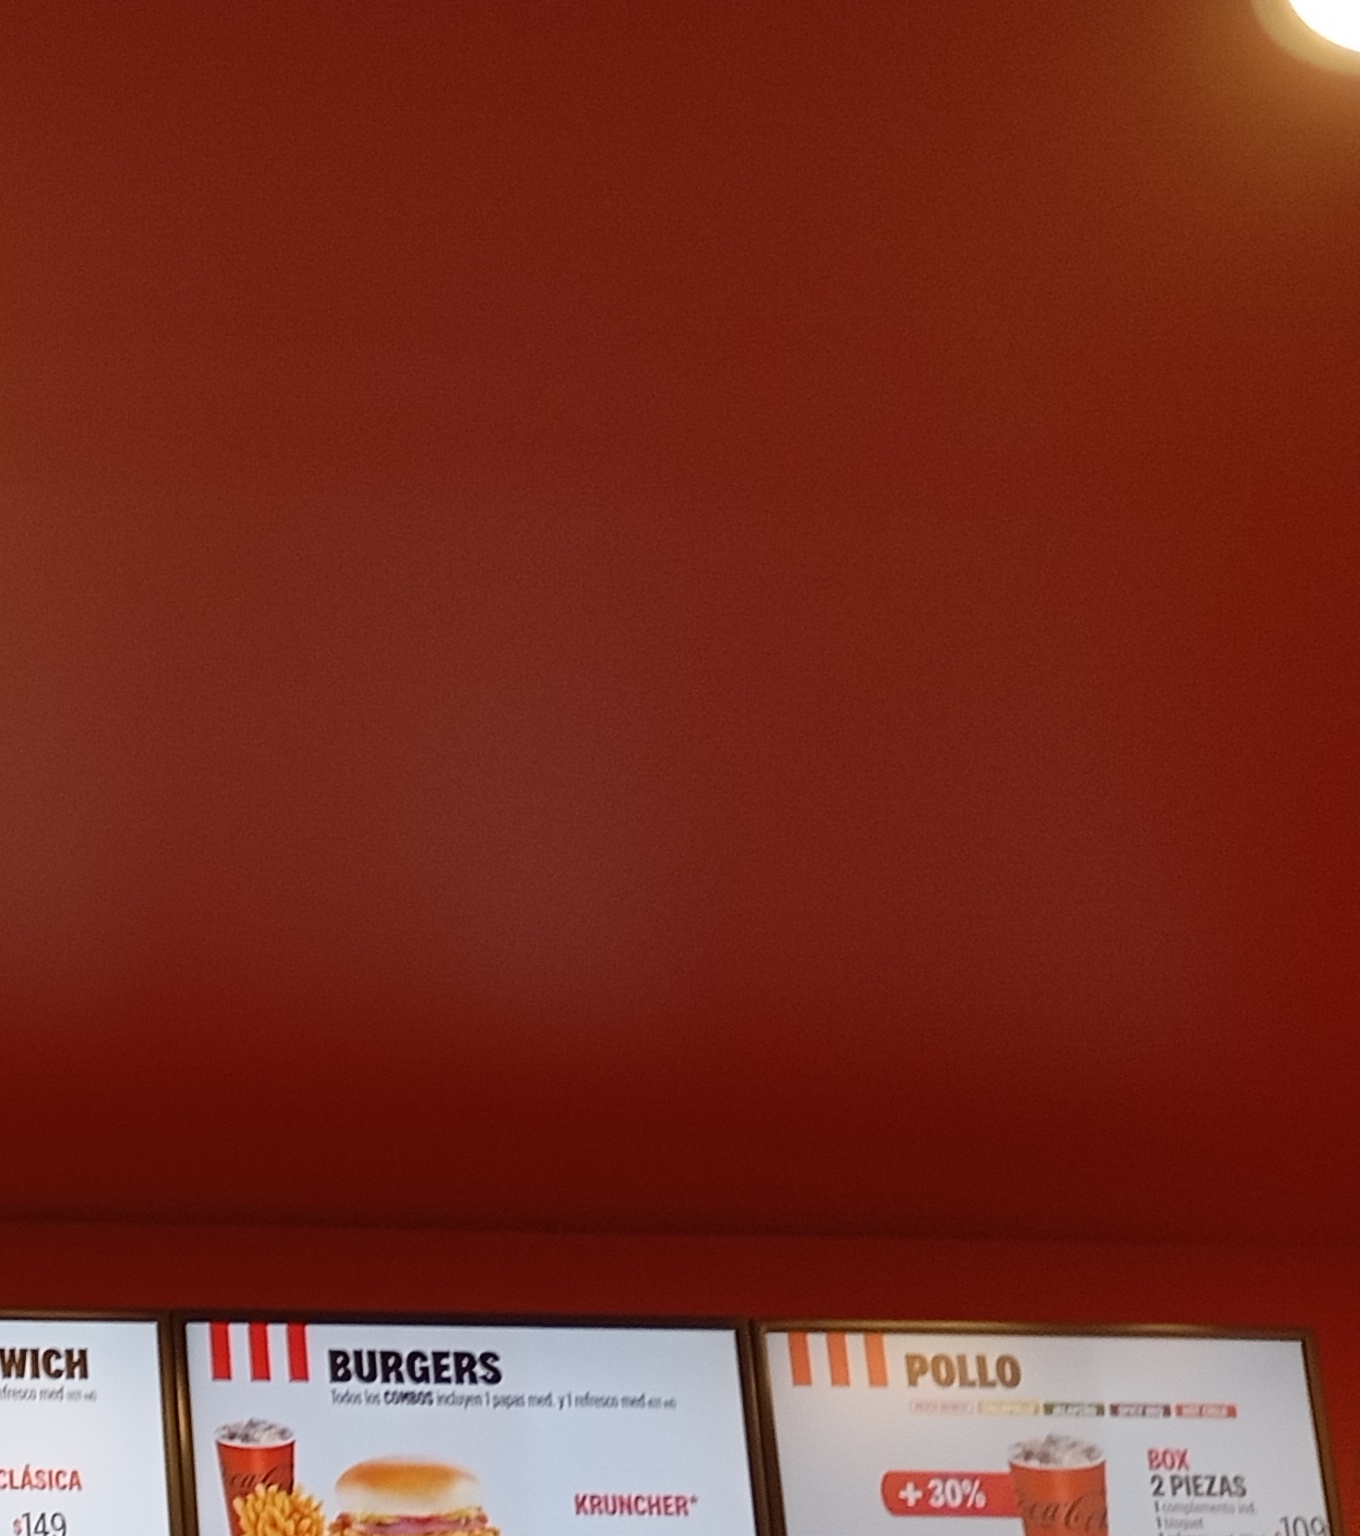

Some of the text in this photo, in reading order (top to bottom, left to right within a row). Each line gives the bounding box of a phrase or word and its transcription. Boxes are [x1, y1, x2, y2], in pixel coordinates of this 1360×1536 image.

[327, 1350, 503, 1384] BURGERS
[905, 1354, 1022, 1387] POLLO
[1148, 1450, 1190, 1470] BOX
[928, 1479, 986, 1509] 30%
[1151, 1475, 1247, 1498] 2 PIEZAS
